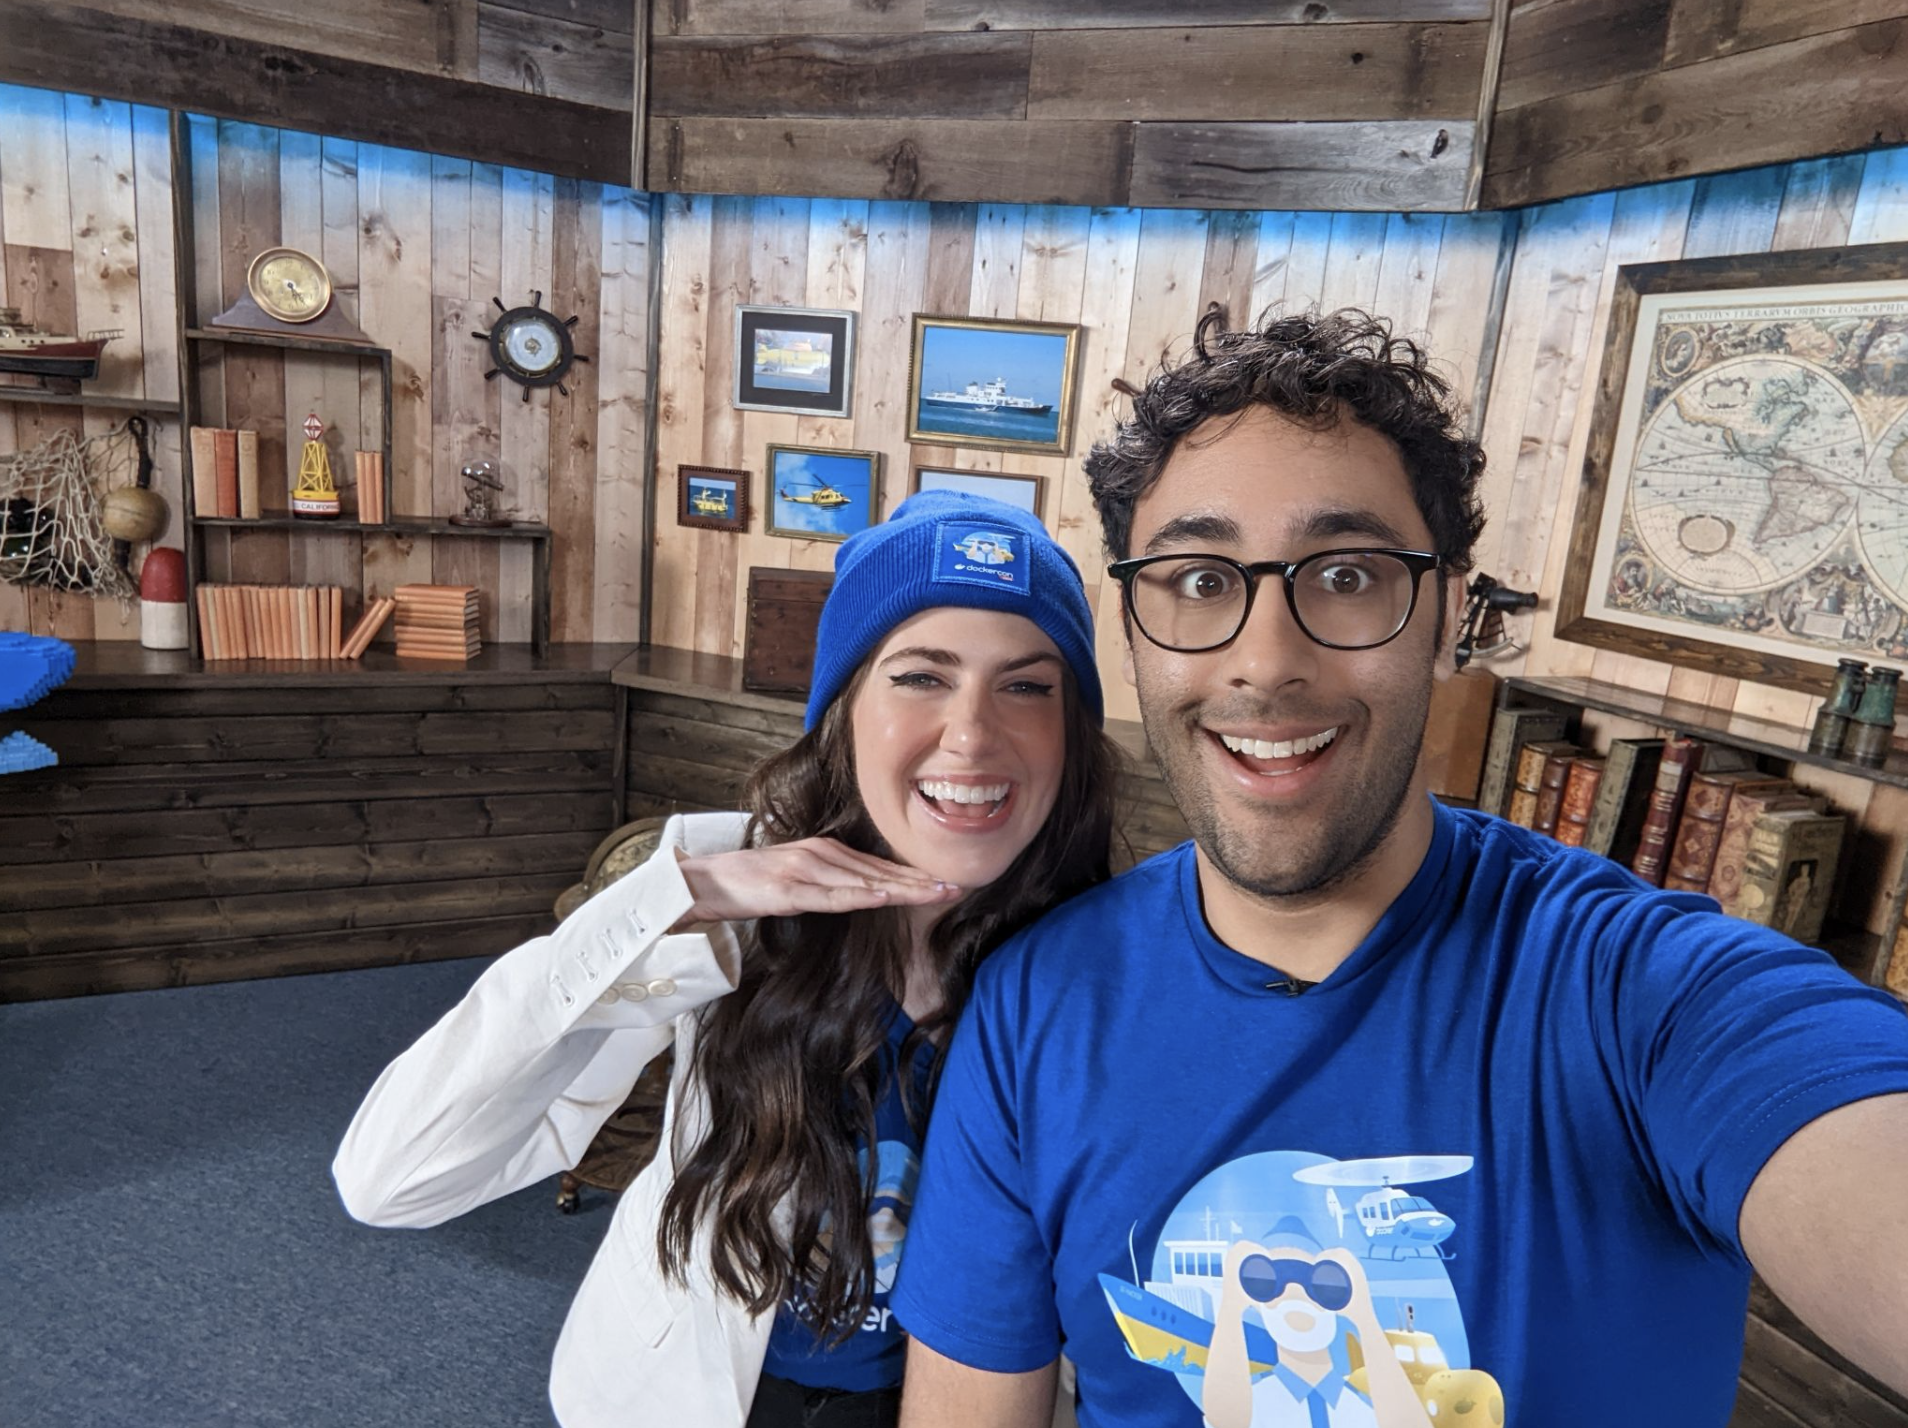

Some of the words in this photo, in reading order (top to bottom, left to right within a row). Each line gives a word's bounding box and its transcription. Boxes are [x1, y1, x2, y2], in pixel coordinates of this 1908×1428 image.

[1666, 311, 1691, 321] NOVA
[1793, 306, 1826, 317] ORBIS
[966, 565, 1013, 578] dockercon
